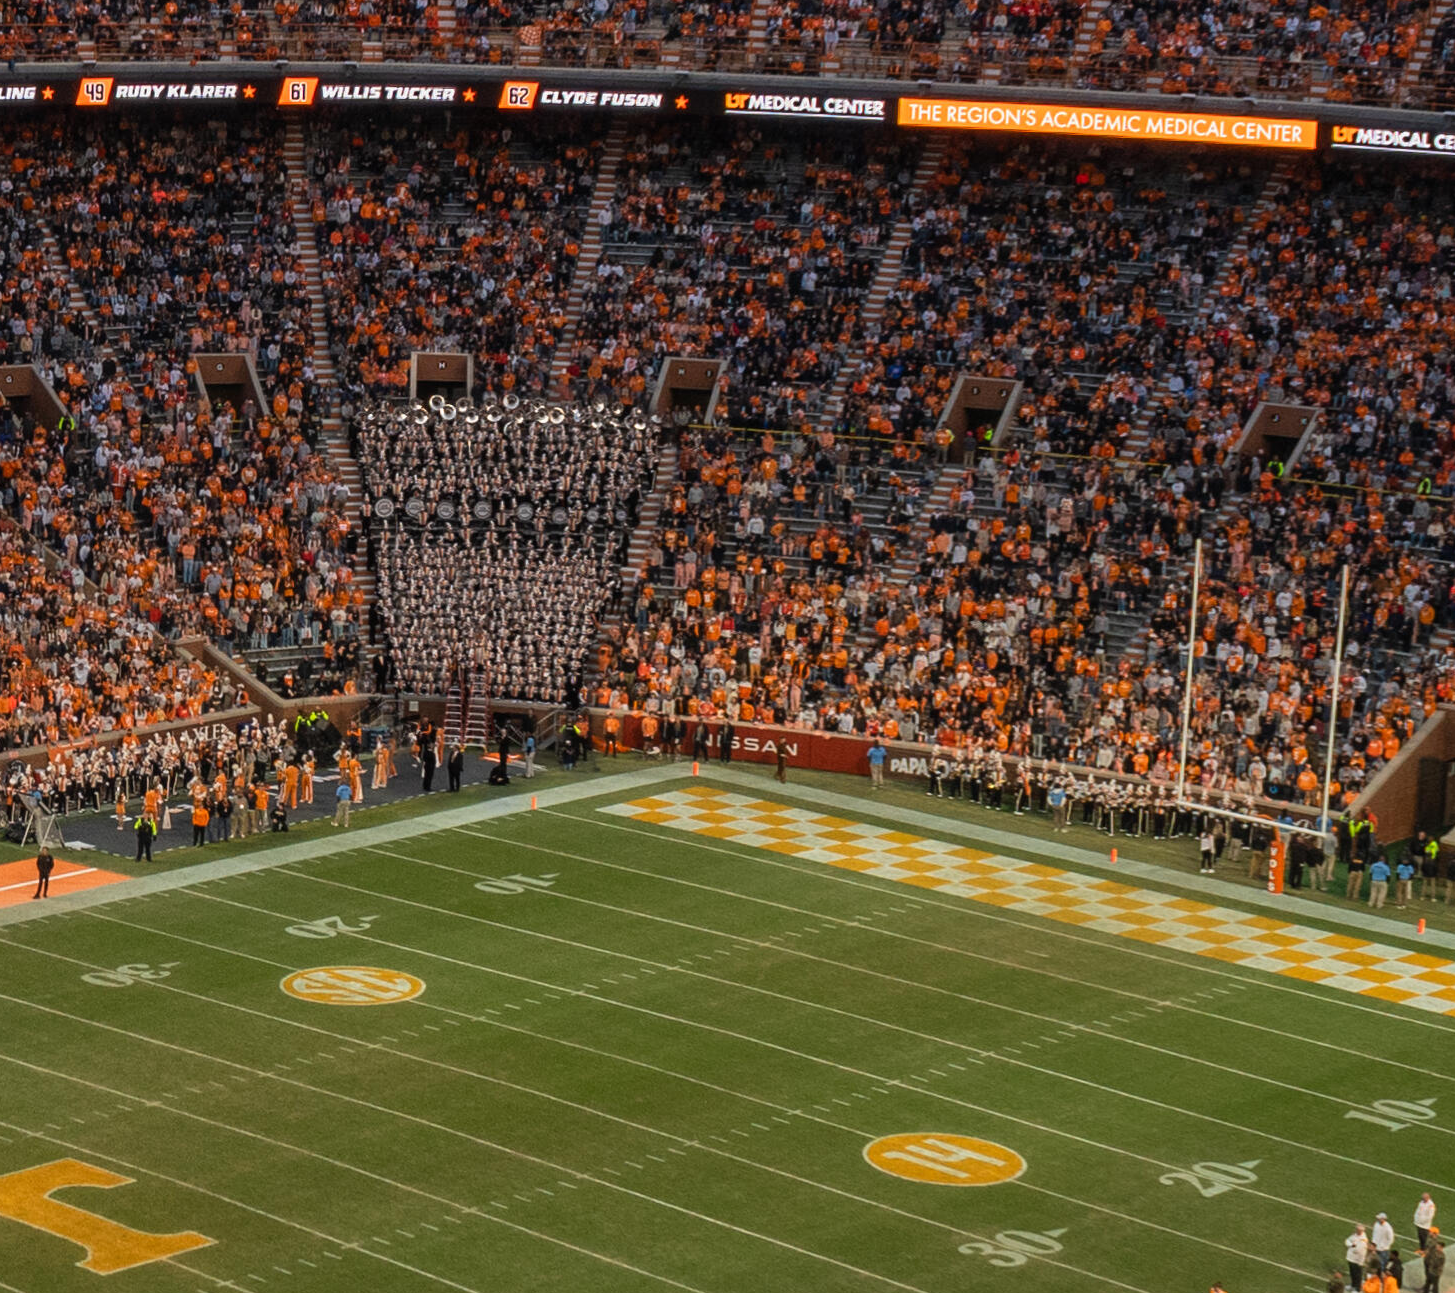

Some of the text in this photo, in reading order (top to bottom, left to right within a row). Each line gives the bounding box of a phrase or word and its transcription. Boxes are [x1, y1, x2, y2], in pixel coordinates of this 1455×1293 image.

[84, 83, 238, 102] 49 RUDY KLARER
[290, 83, 455, 102] 61 WILLIS TUCKER
[509, 86, 662, 107] 62 CLYDE FUSON
[748, 96, 884, 116] MEDICAL CENTER
[910, 104, 1302, 143] THE REGION'S ACADEMIC MEDICAL CENTER
[1355, 129, 1431, 150] MEDICAL
[891, 757, 928, 777] PAPA
[1343, 1099, 1437, 1131] 10
[1159, 1161, 1258, 1197] 20
[958, 1230, 1065, 1267] 30
